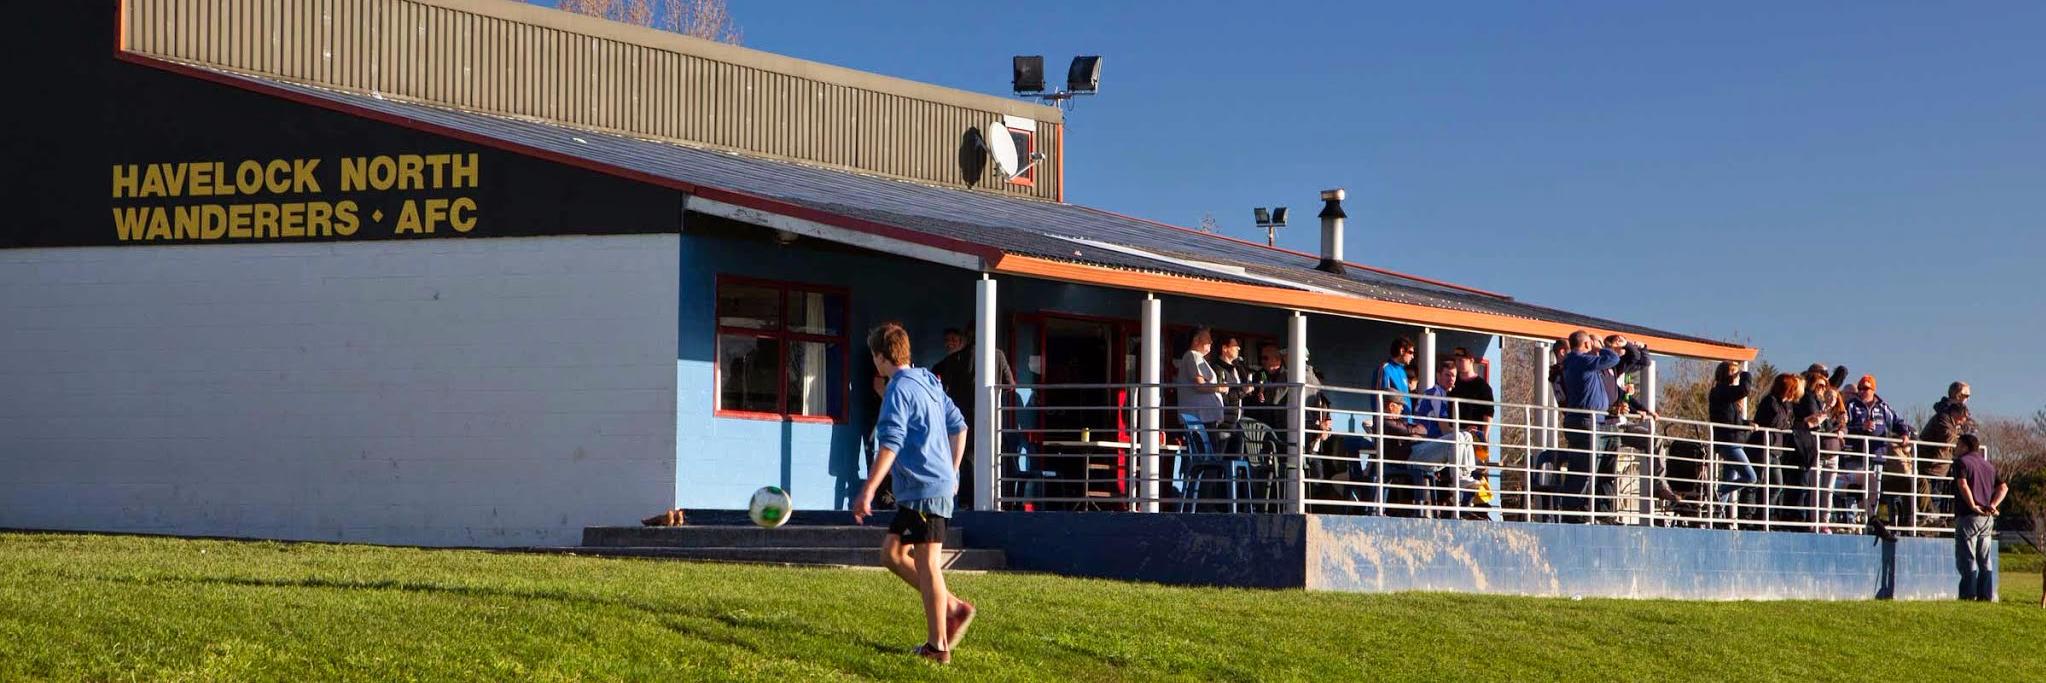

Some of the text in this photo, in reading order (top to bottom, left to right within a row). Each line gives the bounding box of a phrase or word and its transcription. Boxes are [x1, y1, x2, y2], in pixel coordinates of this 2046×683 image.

[112, 153, 479, 198] HAVELOCK NORTH
[112, 197, 477, 241] WANDERERS AFC
